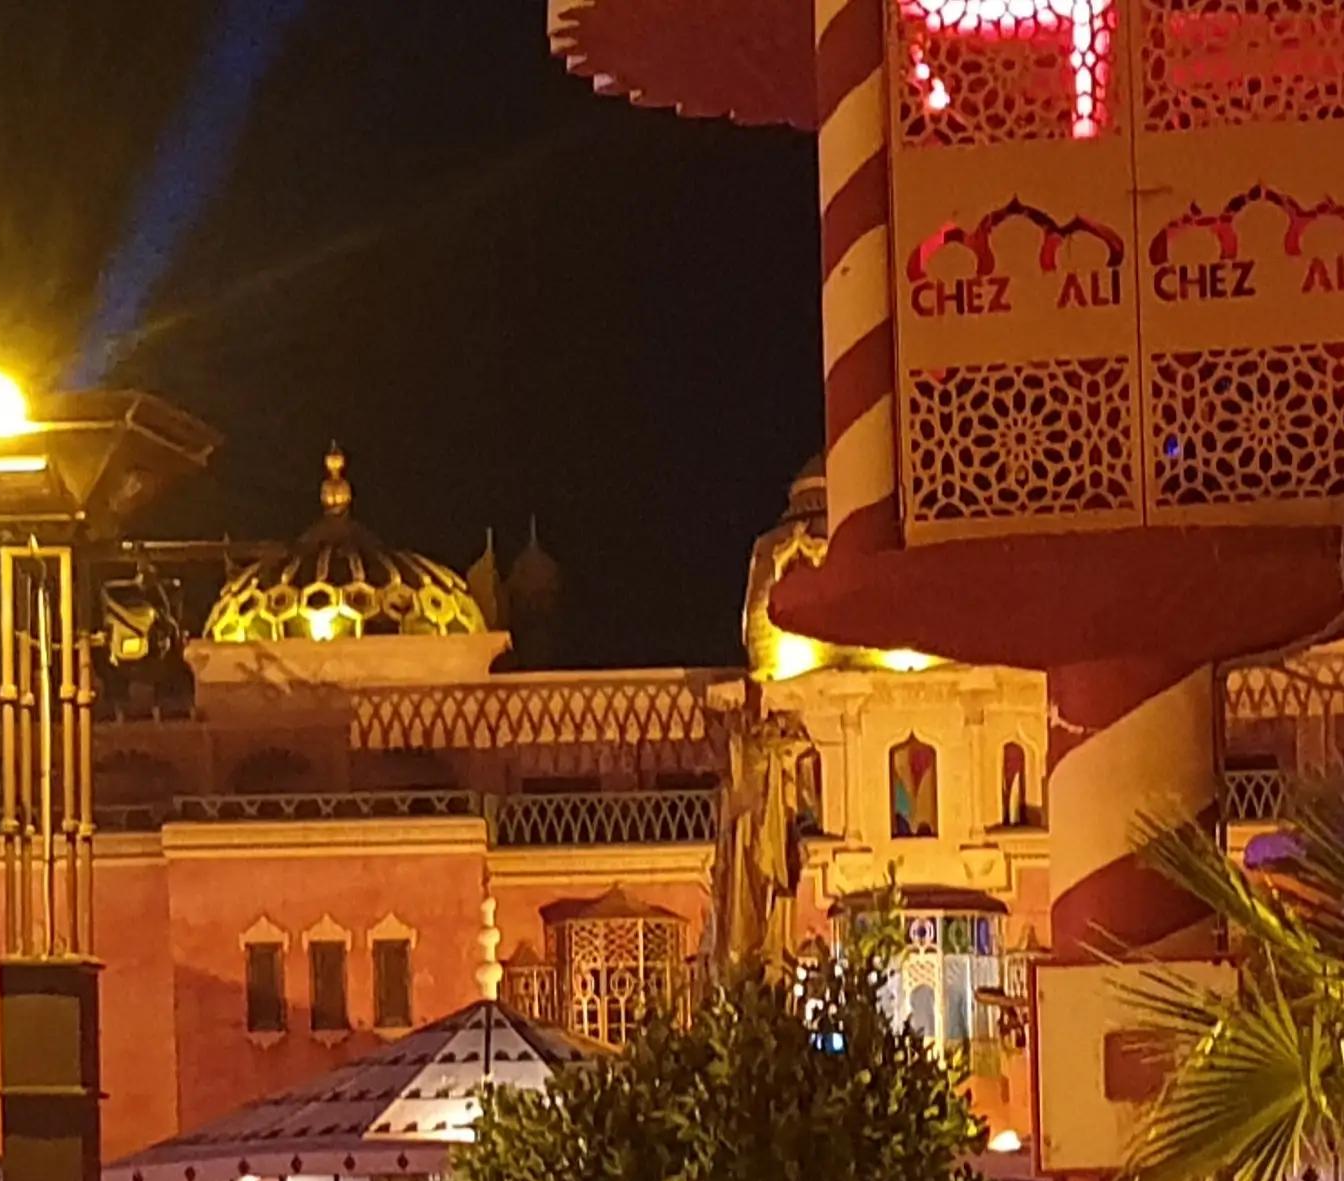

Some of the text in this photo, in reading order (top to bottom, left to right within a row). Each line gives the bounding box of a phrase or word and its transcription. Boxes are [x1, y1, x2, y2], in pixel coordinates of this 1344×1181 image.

[911, 269, 1121, 317] CHEZ ALI
[1153, 260, 1256, 301] CHEZ
